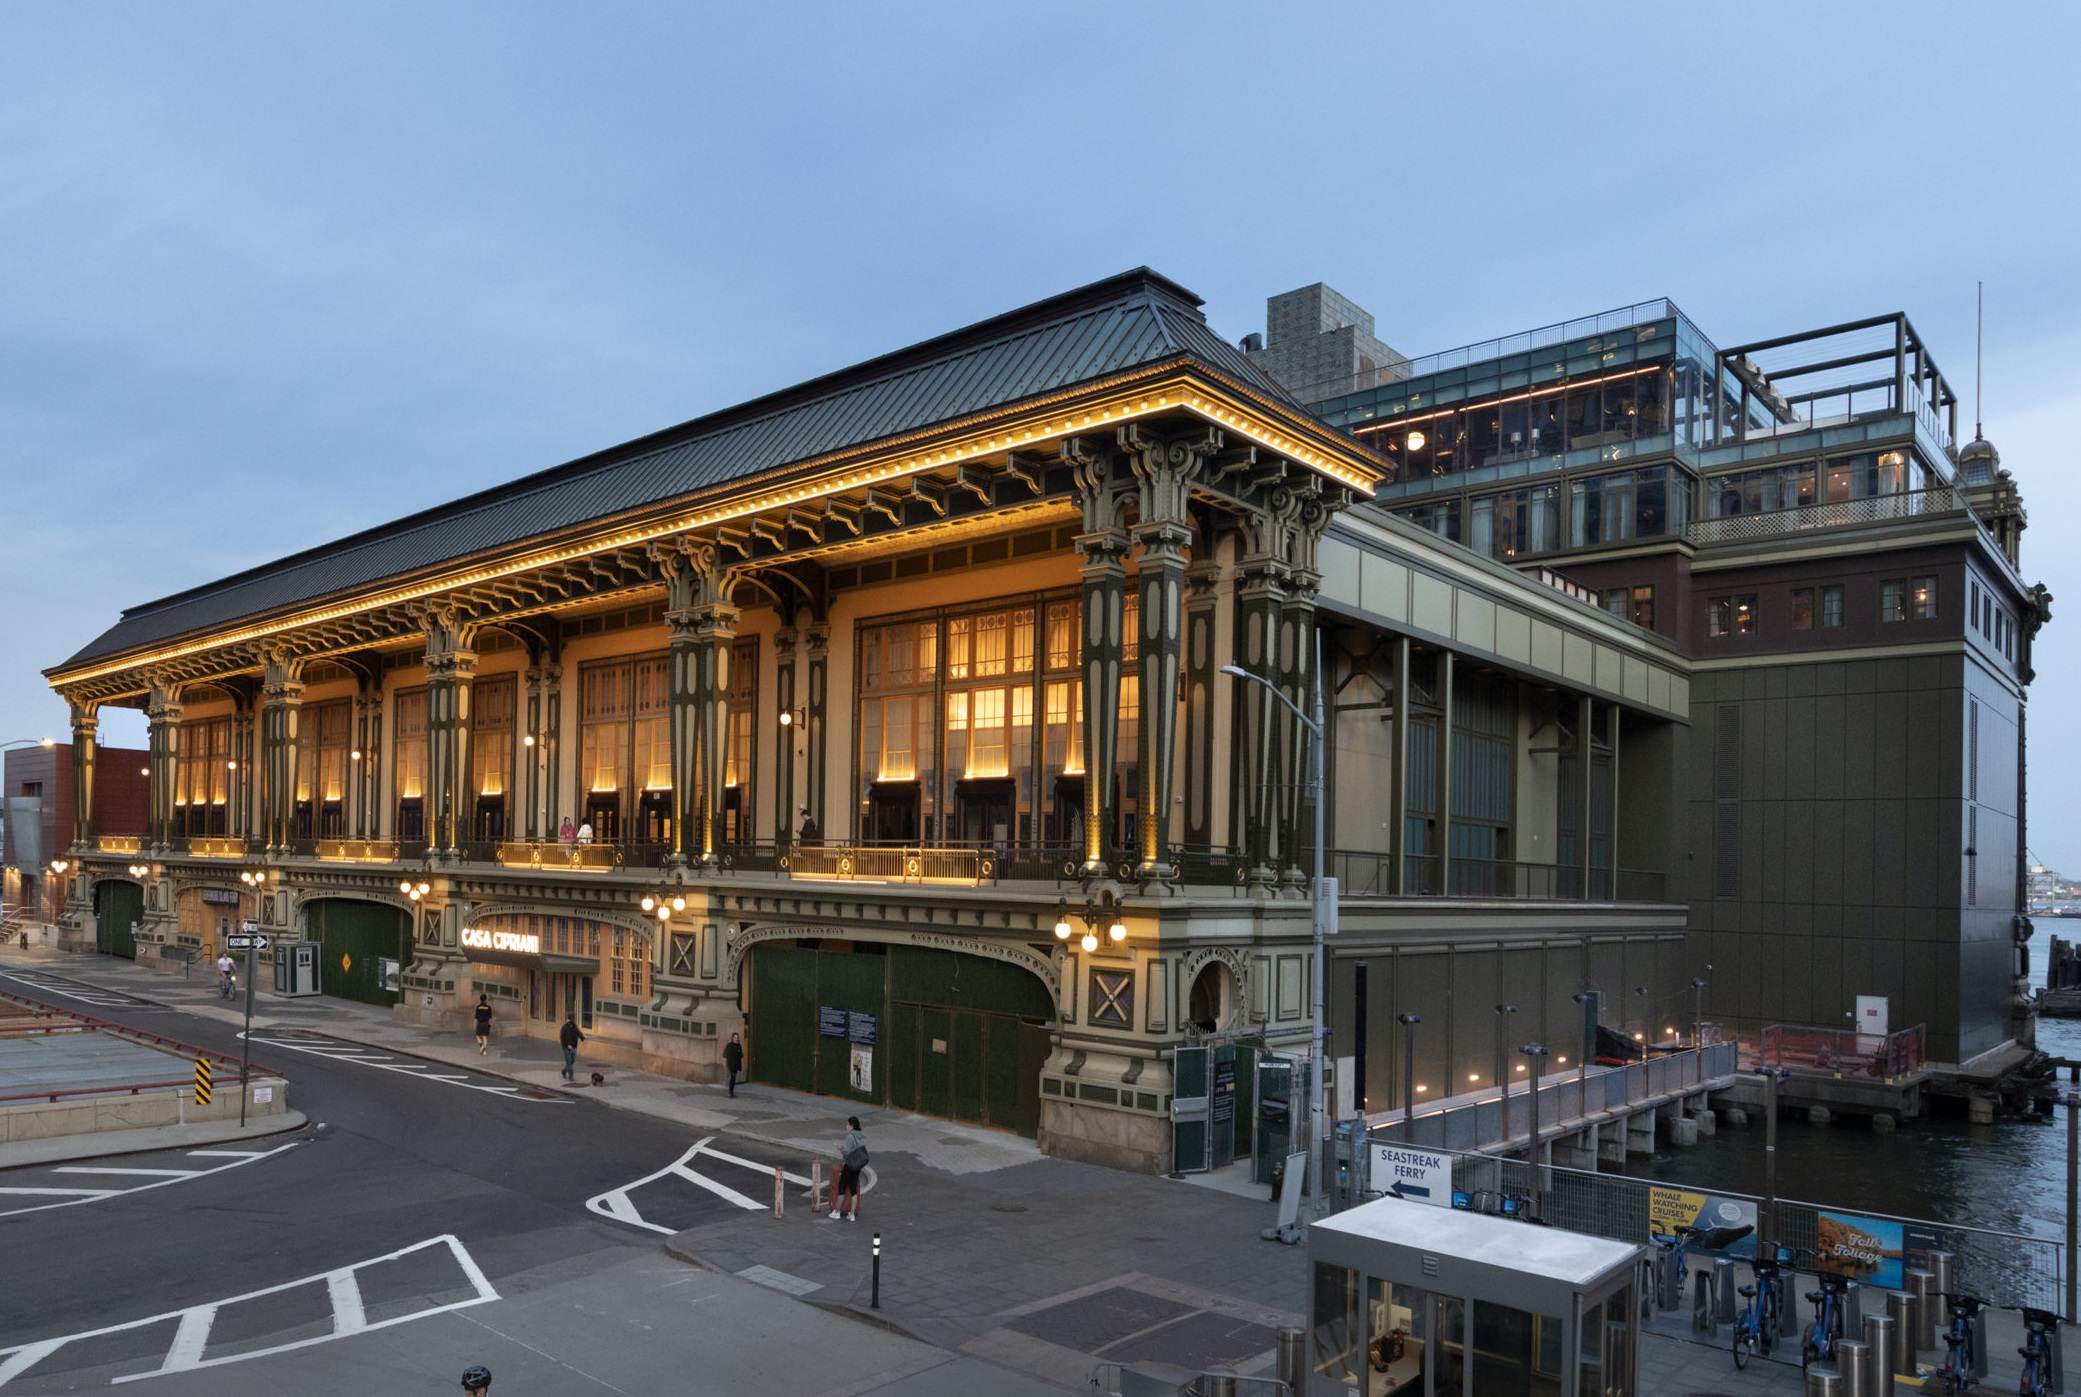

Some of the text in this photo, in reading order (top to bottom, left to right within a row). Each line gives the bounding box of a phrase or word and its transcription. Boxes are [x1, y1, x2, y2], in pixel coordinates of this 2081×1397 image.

[231, 938, 244, 946] ONE
[462, 928, 539, 953] CASA CIPRIANI
[1381, 1149, 1441, 1169] SEASTREAK
[1395, 1165, 1426, 1179] FERRY
[1653, 1190, 1682, 1200] WHALE
[1652, 1199, 1698, 1212] WATCHING
[1652, 1206, 1685, 1218] CRUISES
[1848, 1233, 1877, 1247] Fall
[1833, 1244, 1884, 1264] Foliage
